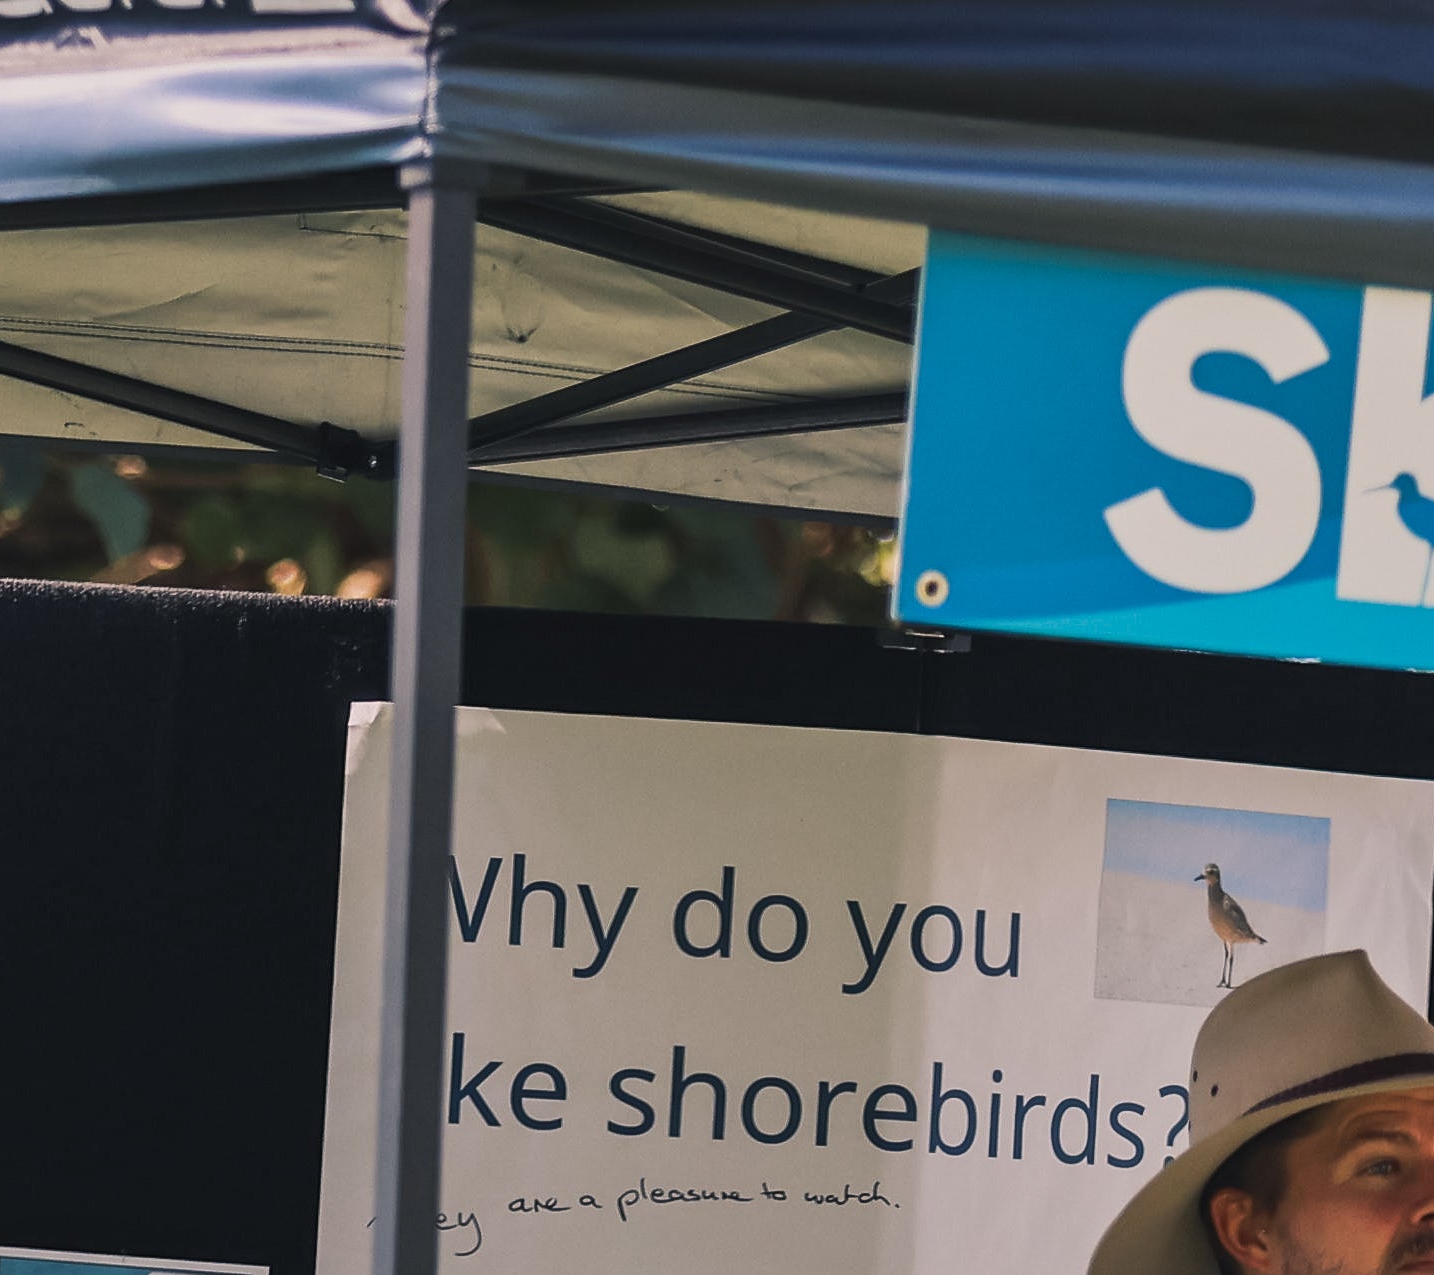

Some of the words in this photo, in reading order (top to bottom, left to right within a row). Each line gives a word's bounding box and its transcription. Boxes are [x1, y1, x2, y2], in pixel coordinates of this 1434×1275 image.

[672, 864, 810, 963] do
[841, 898, 1023, 996] you
[447, 1031, 569, 1132] ke
[605, 1044, 1190, 1172] shorebirds?
[435, 1210, 483, 1257] ey
[507, 1197, 572, 1215] are
[579, 1195, 603, 1210] a
[617, 1177, 753, 1223] pleasure
[759, 1182, 788, 1203] to
[804, 1181, 901, 1209] watch.
